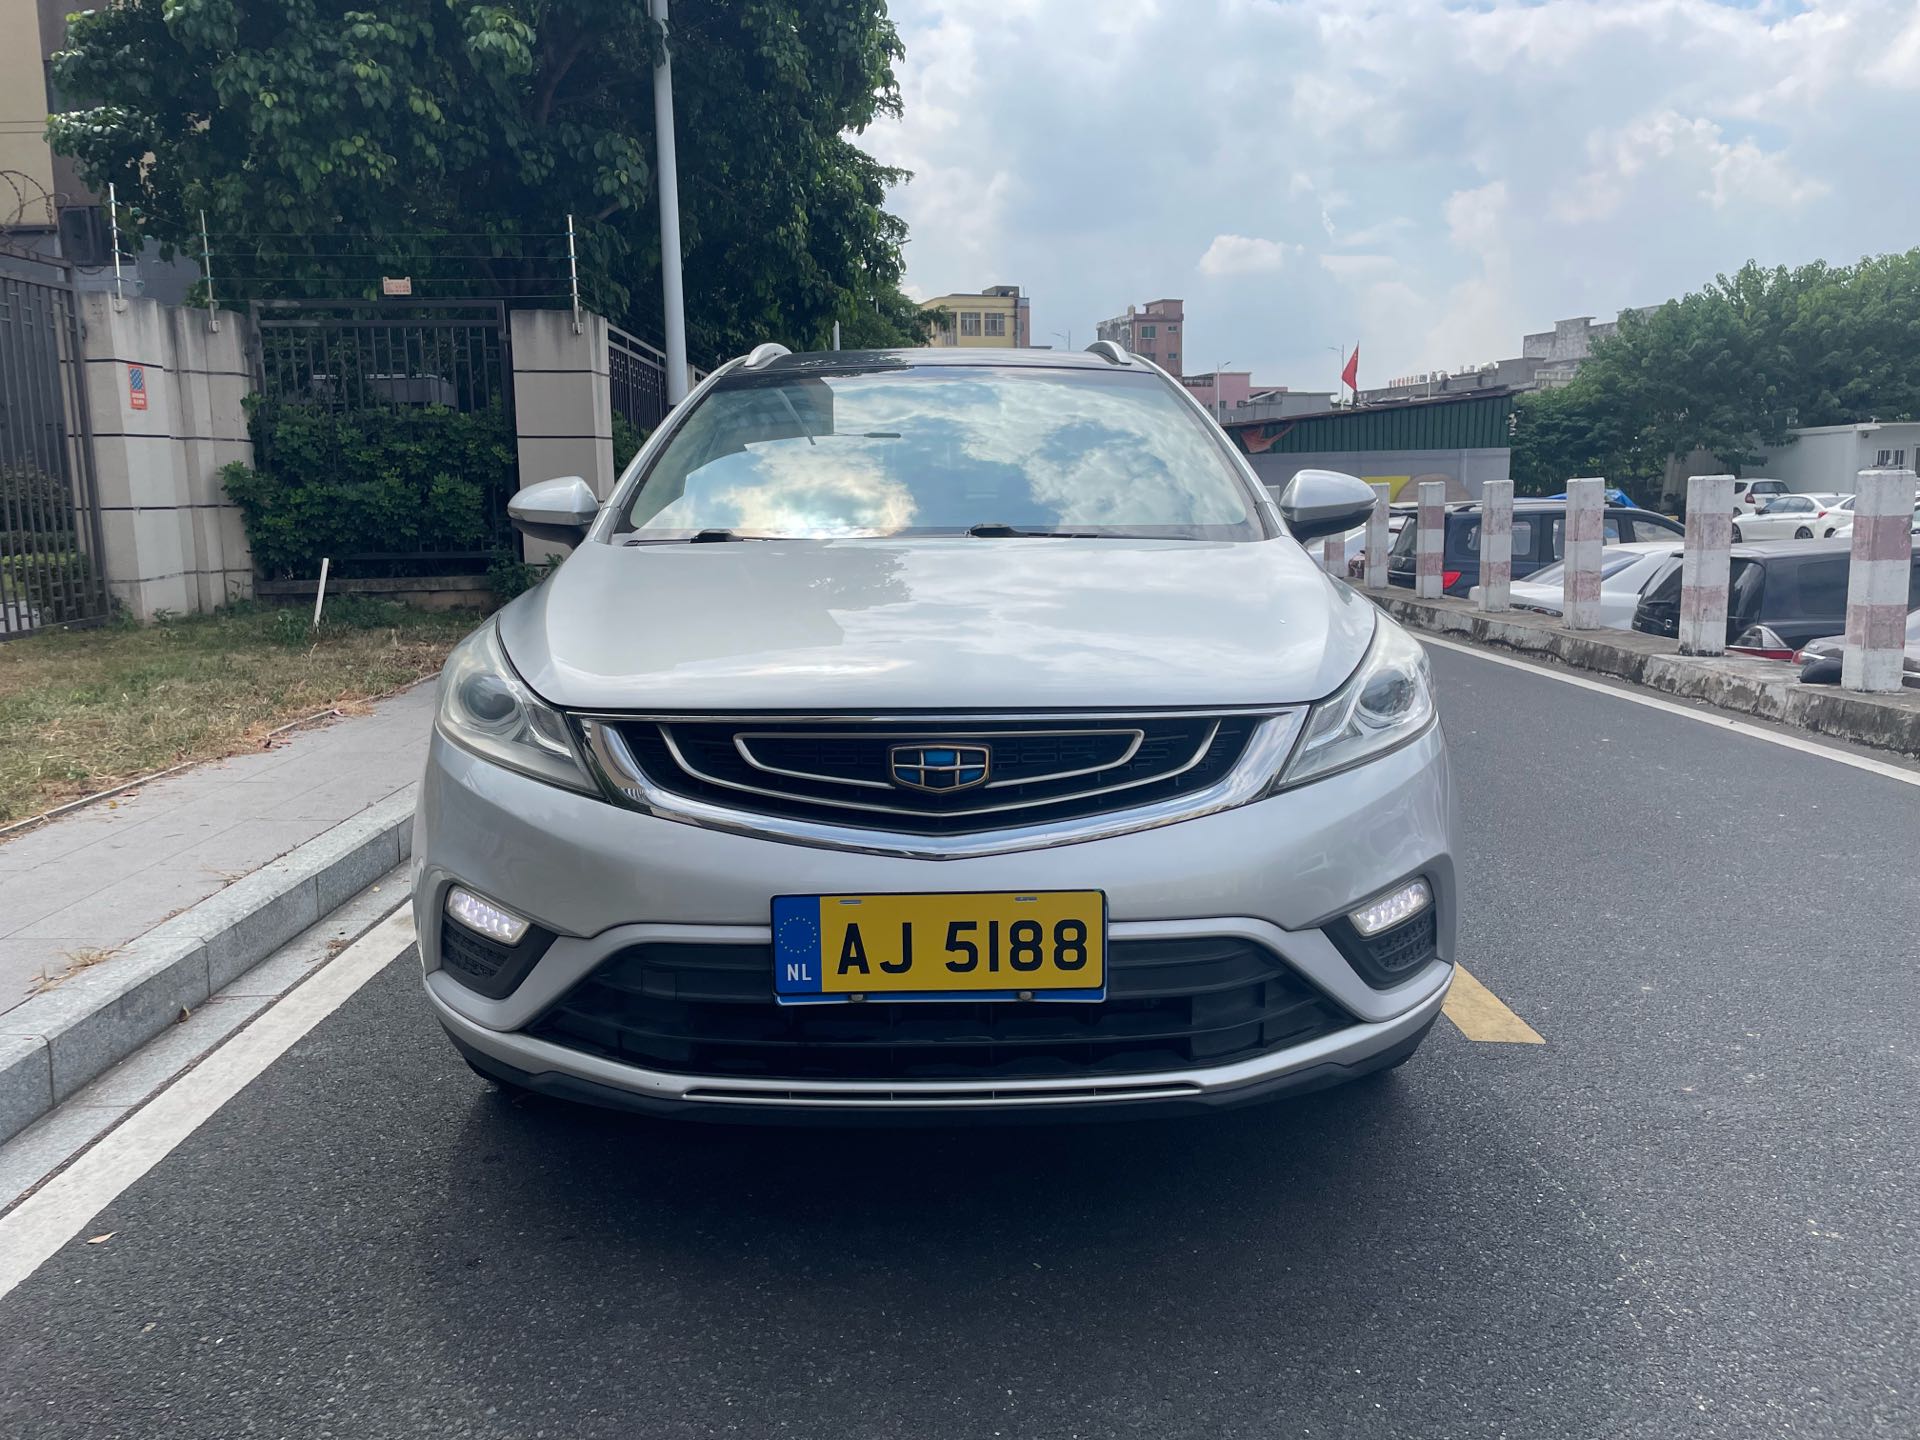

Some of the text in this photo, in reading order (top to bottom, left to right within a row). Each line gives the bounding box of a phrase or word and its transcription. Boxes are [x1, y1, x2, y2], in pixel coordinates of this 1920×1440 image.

[837, 919, 1088, 974] AJ 5188
[787, 963, 812, 981] NL
